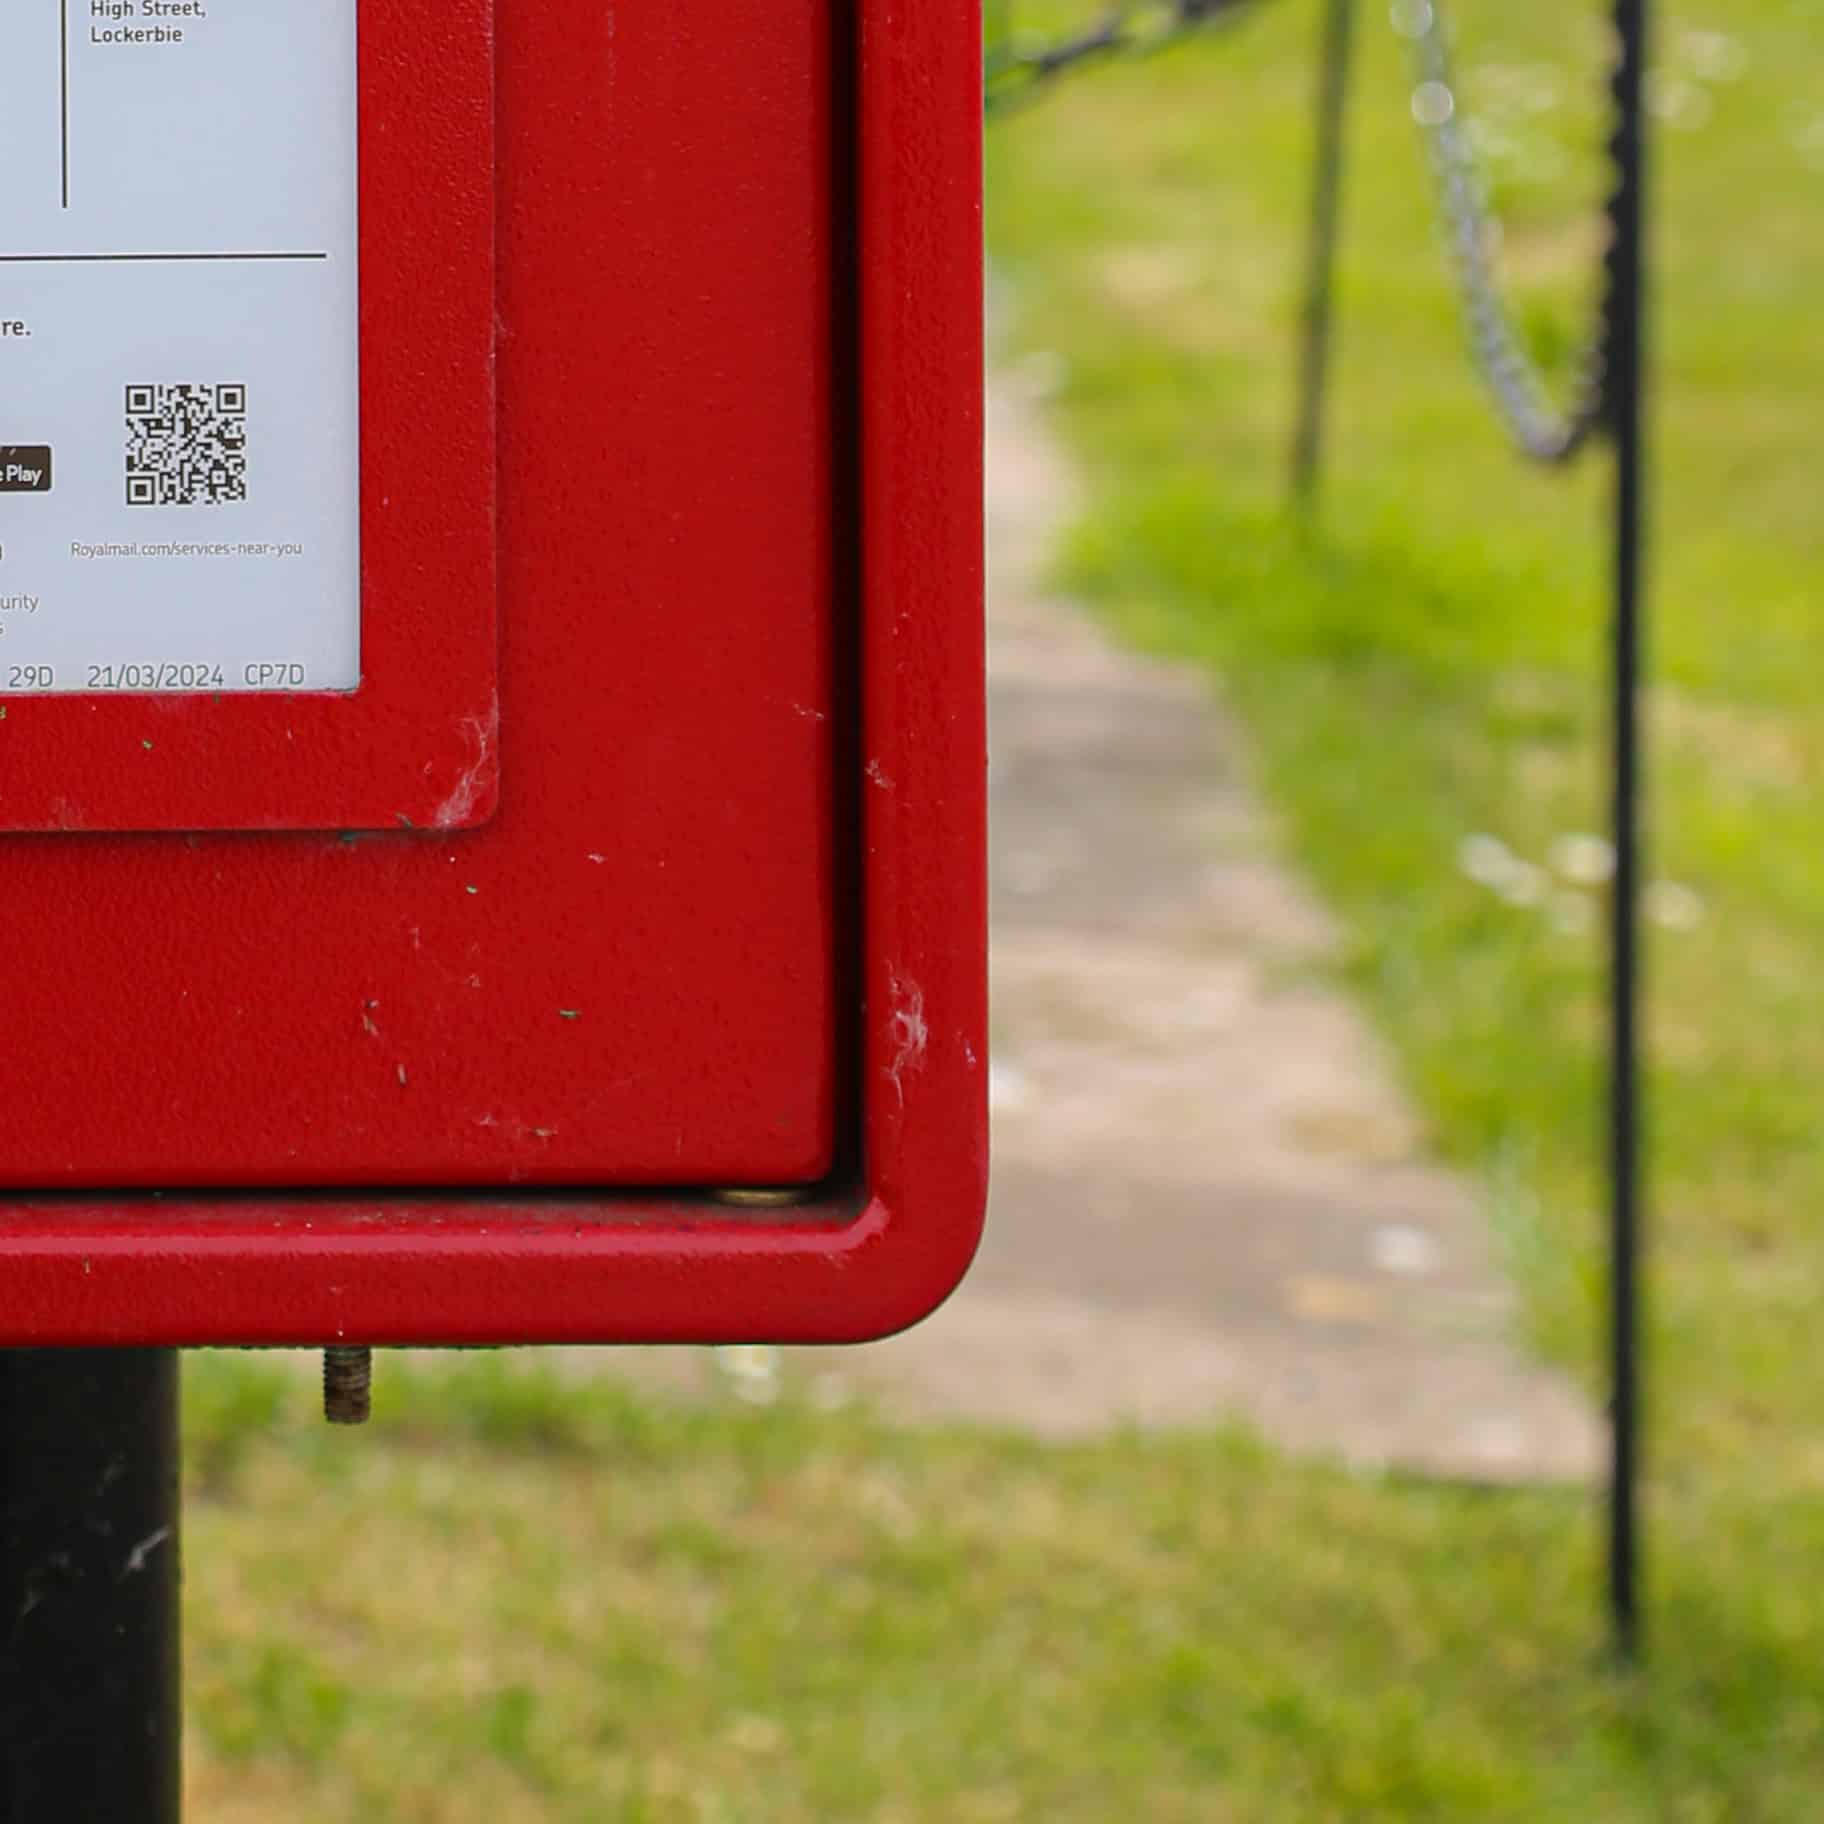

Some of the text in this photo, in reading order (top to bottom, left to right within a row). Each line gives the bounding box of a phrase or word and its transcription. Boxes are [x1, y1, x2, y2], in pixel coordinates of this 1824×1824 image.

[91, 0, 205, 20] High Street,
[92, 26, 182, 42] Lockerbie
[7, 465, 42, 485] Play
[9, 666, 53, 688] 29D
[87, 665, 223, 689] 21/03/2024
[245, 663, 304, 686] CP7D
